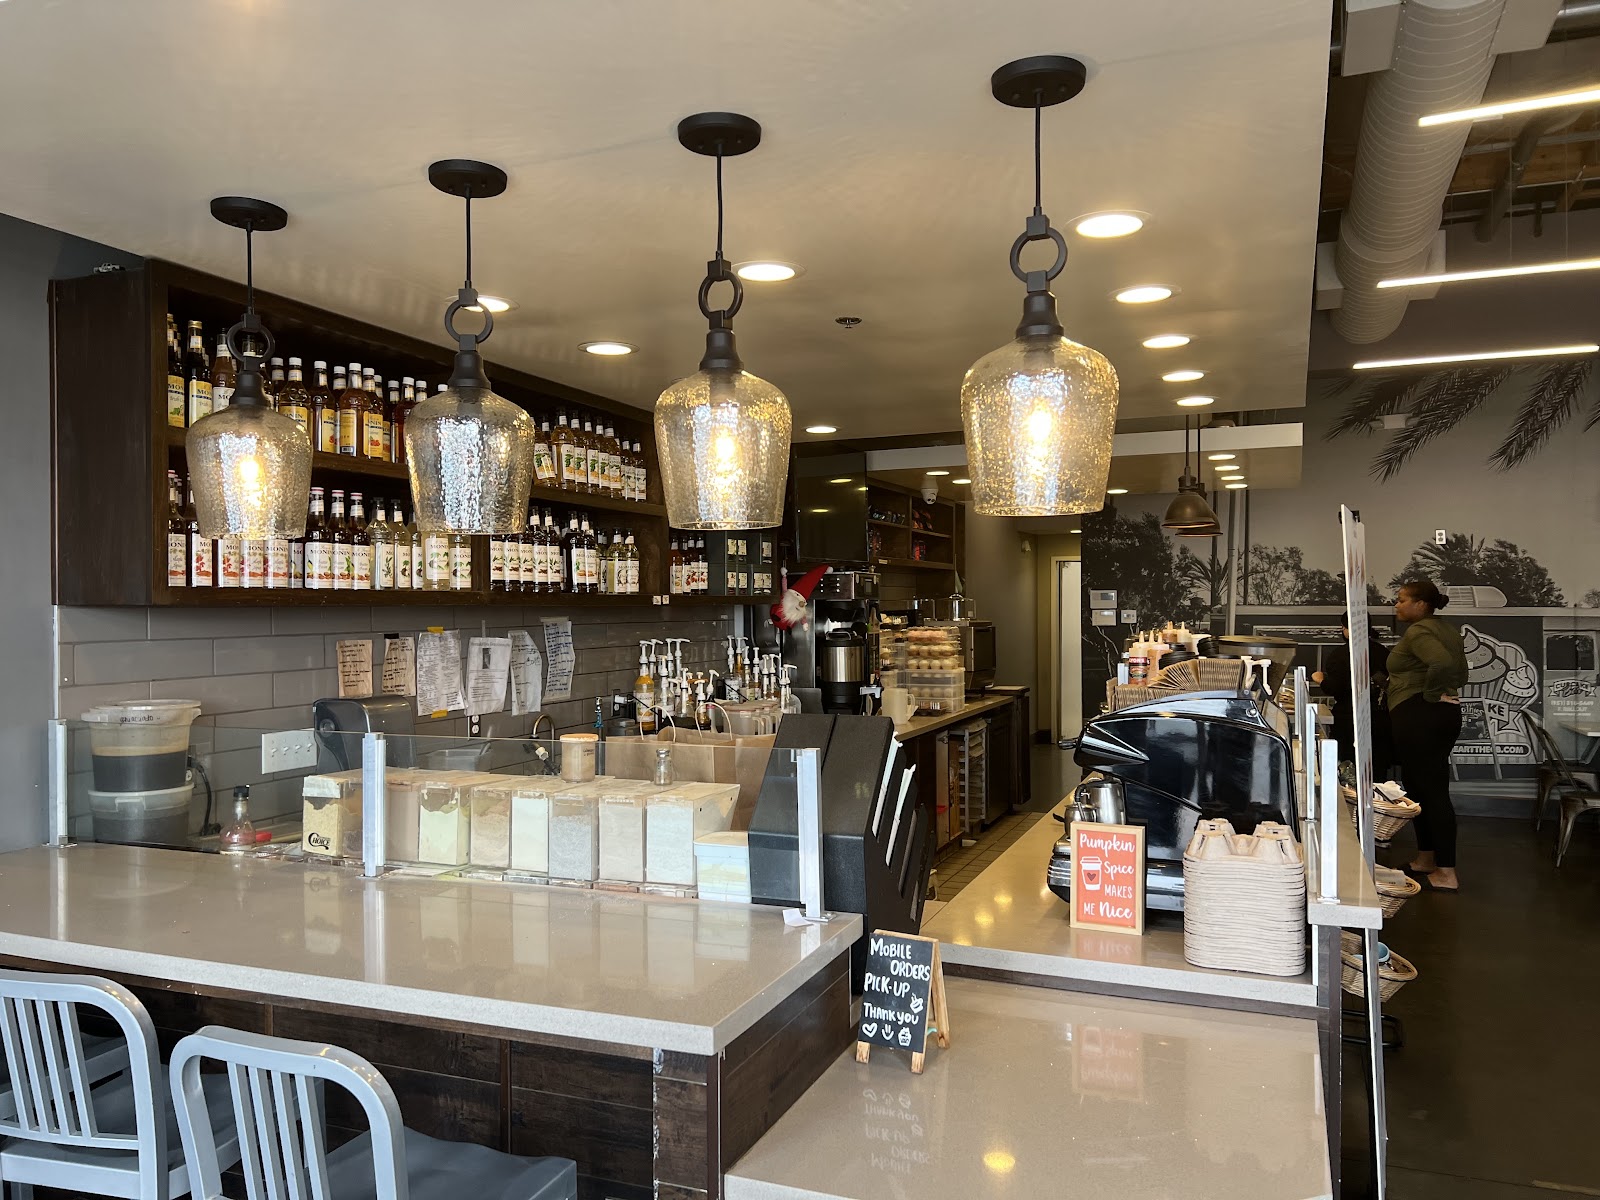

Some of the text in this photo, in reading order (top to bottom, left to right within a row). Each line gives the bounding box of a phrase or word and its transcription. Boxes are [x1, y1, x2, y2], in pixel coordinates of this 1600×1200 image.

[1079, 833, 1136, 858] Pumpkin
[1104, 860, 1135, 881] Spice
[1104, 884, 1133, 899] MAKES
[1083, 901, 1133, 919] ME Nice
[869, 937, 912, 960] MOBILE
[890, 959, 931, 982] ORDERS
[864, 972, 911, 998] PICK-UP
